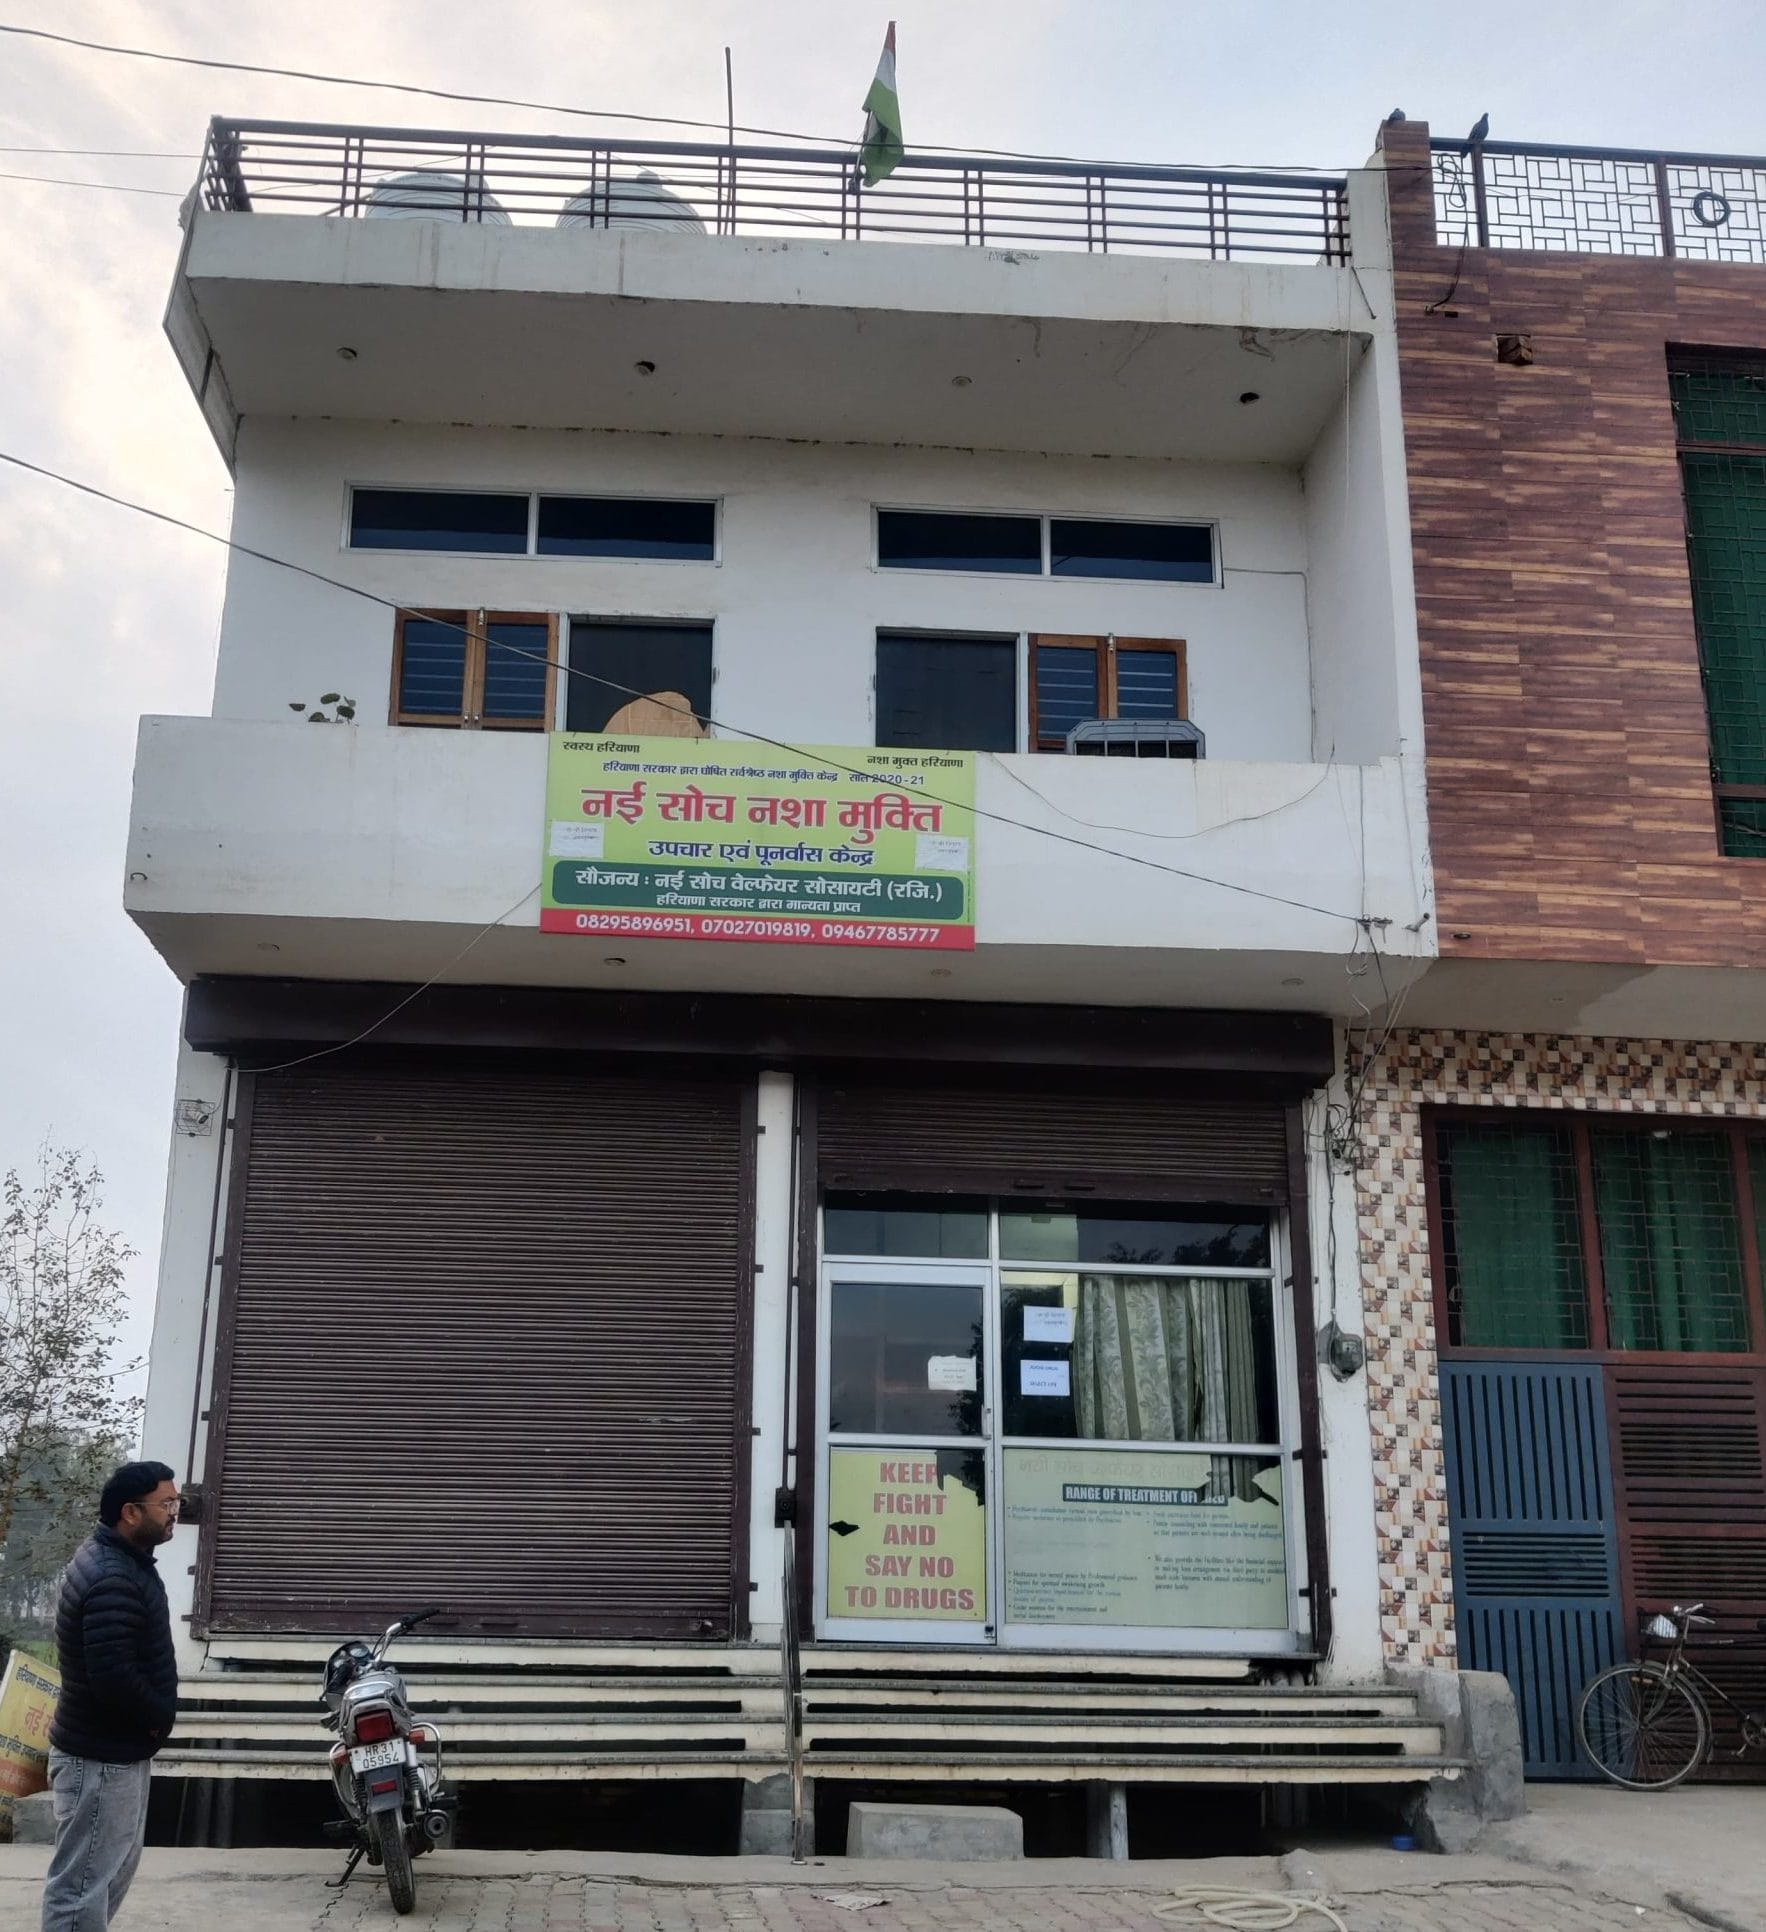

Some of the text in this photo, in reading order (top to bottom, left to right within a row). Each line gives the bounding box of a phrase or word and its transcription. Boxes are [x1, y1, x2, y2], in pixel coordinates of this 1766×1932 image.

[563, 741, 640, 753] स्वस्थ हरियाणा
[603, 760, 640, 772] हरियाणा
[643, 764, 676, 774] सरकार
[768, 770, 786, 779] नशा
[867, 755, 963, 769] नशा मुक्त हरियाणा
[581, 781, 943, 844] नई सोच नशा मुक्ति
[648, 840, 713, 857] उपचार
[719, 840, 750, 862] एवं
[828, 845, 874, 866] केन्द्र
[575, 866, 639, 887] सौजन्य
[654, 870, 685, 890] नई
[689, 871, 726, 891] सोच
[730, 873, 799, 893] वेल्फेयर
[804, 877, 881, 897] सोसायटी
[887, 880, 942, 902] (रजि.)
[656, 892, 705, 907] हरियाणा
[709, 896, 755, 909] सरकार
[786, 900, 829, 912] मान्यता
[833, 901, 861, 913] प्राप्त
[576, 914, 940, 943] 08295896951, 07027019819, 09467785777
[880, 1462, 938, 1484] KEEP
[873, 1493, 946, 1515] FIGHT
[1065, 1486, 1100, 1500] RANGE
[1103, 1487, 1116, 1500] OF
[1116, 1487, 1179, 1502] TREATMENT
[883, 1524, 936, 1546] AND
[865, 1554, 954, 1578] SAY NO
[844, 1586, 974, 1610] TO DRUGS
